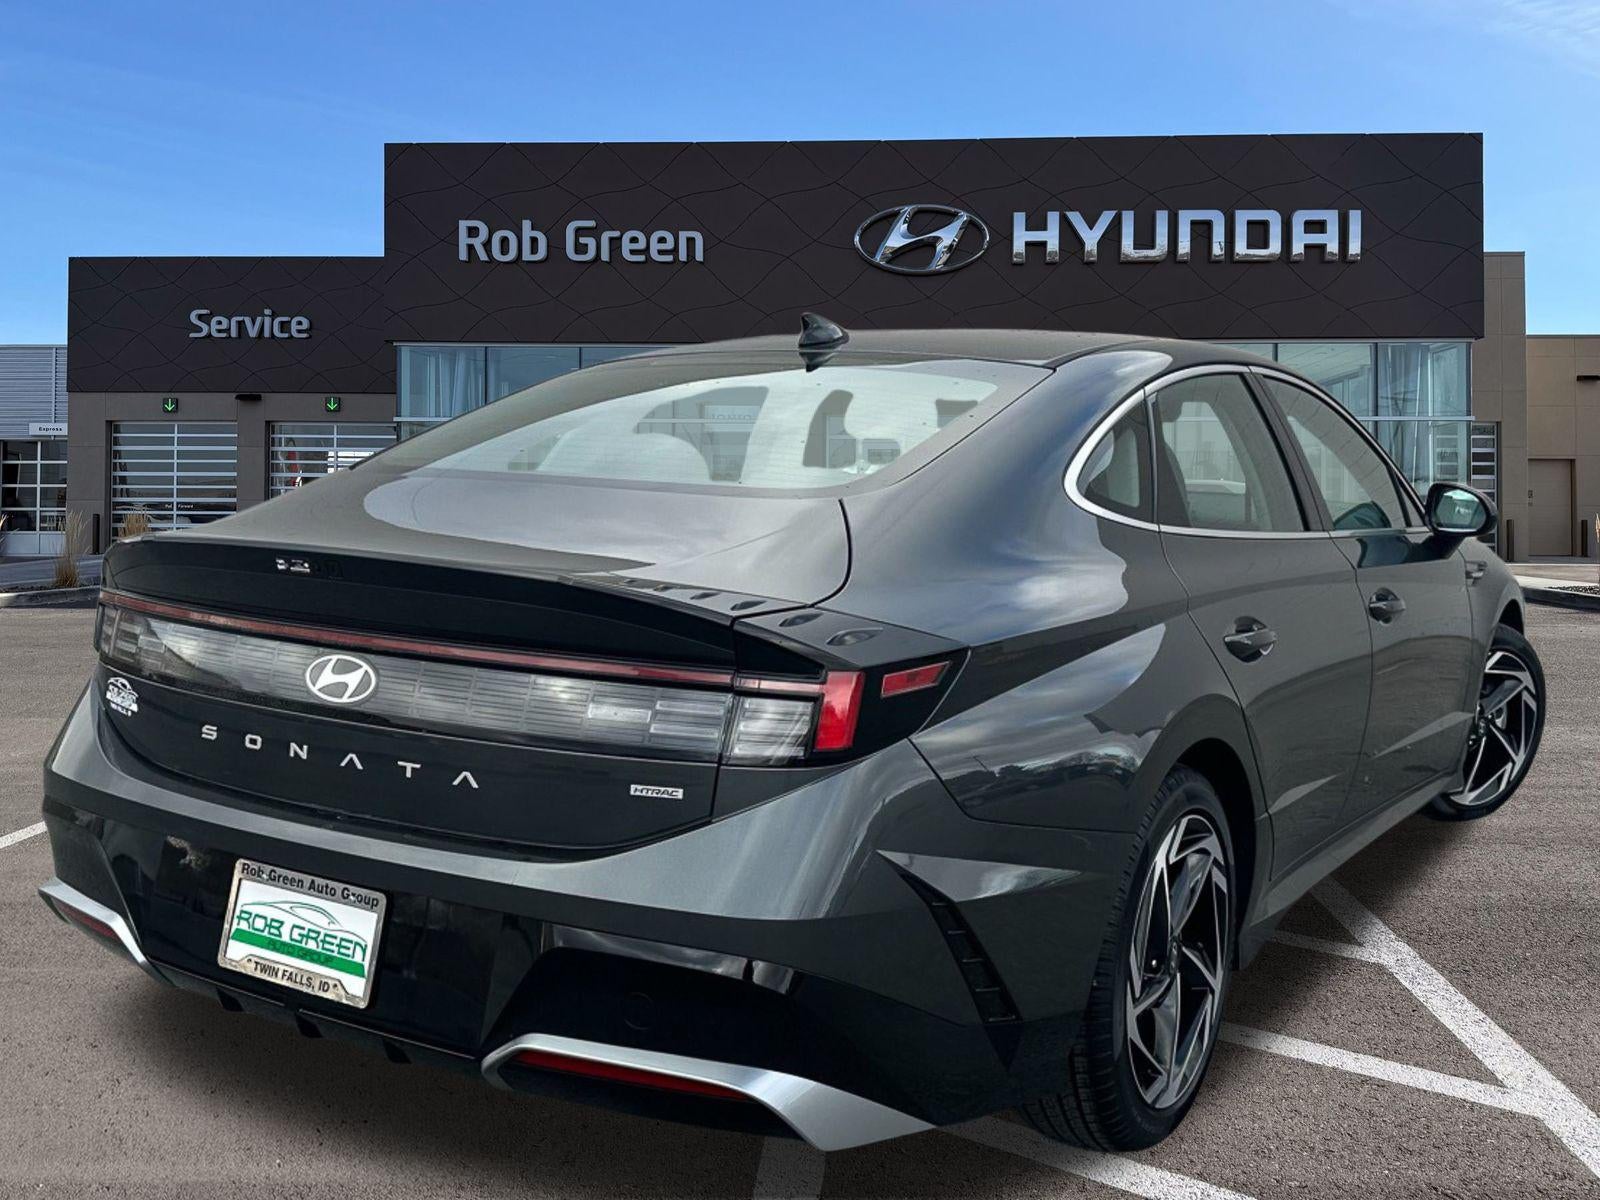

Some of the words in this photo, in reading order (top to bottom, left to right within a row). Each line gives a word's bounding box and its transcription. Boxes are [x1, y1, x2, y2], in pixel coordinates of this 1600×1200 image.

[458, 219, 548, 262] Rob
[565, 219, 704, 262] Green
[1011, 209, 1362, 264] HYUNDAI
[189, 308, 310, 338] Service
[201, 724, 479, 789] SONATA
[632, 786, 681, 798] HTRAC
[241, 862, 265, 879] Rob
[268, 869, 304, 889] Green
[308, 878, 337, 897] Auto
[341, 887, 379, 909] Group
[236, 909, 285, 938] ROB
[289, 924, 368, 962] GREEN
[253, 960, 279, 978] TWIN
[281, 969, 315, 990] FALLS,
[318, 979, 331, 993] ID
